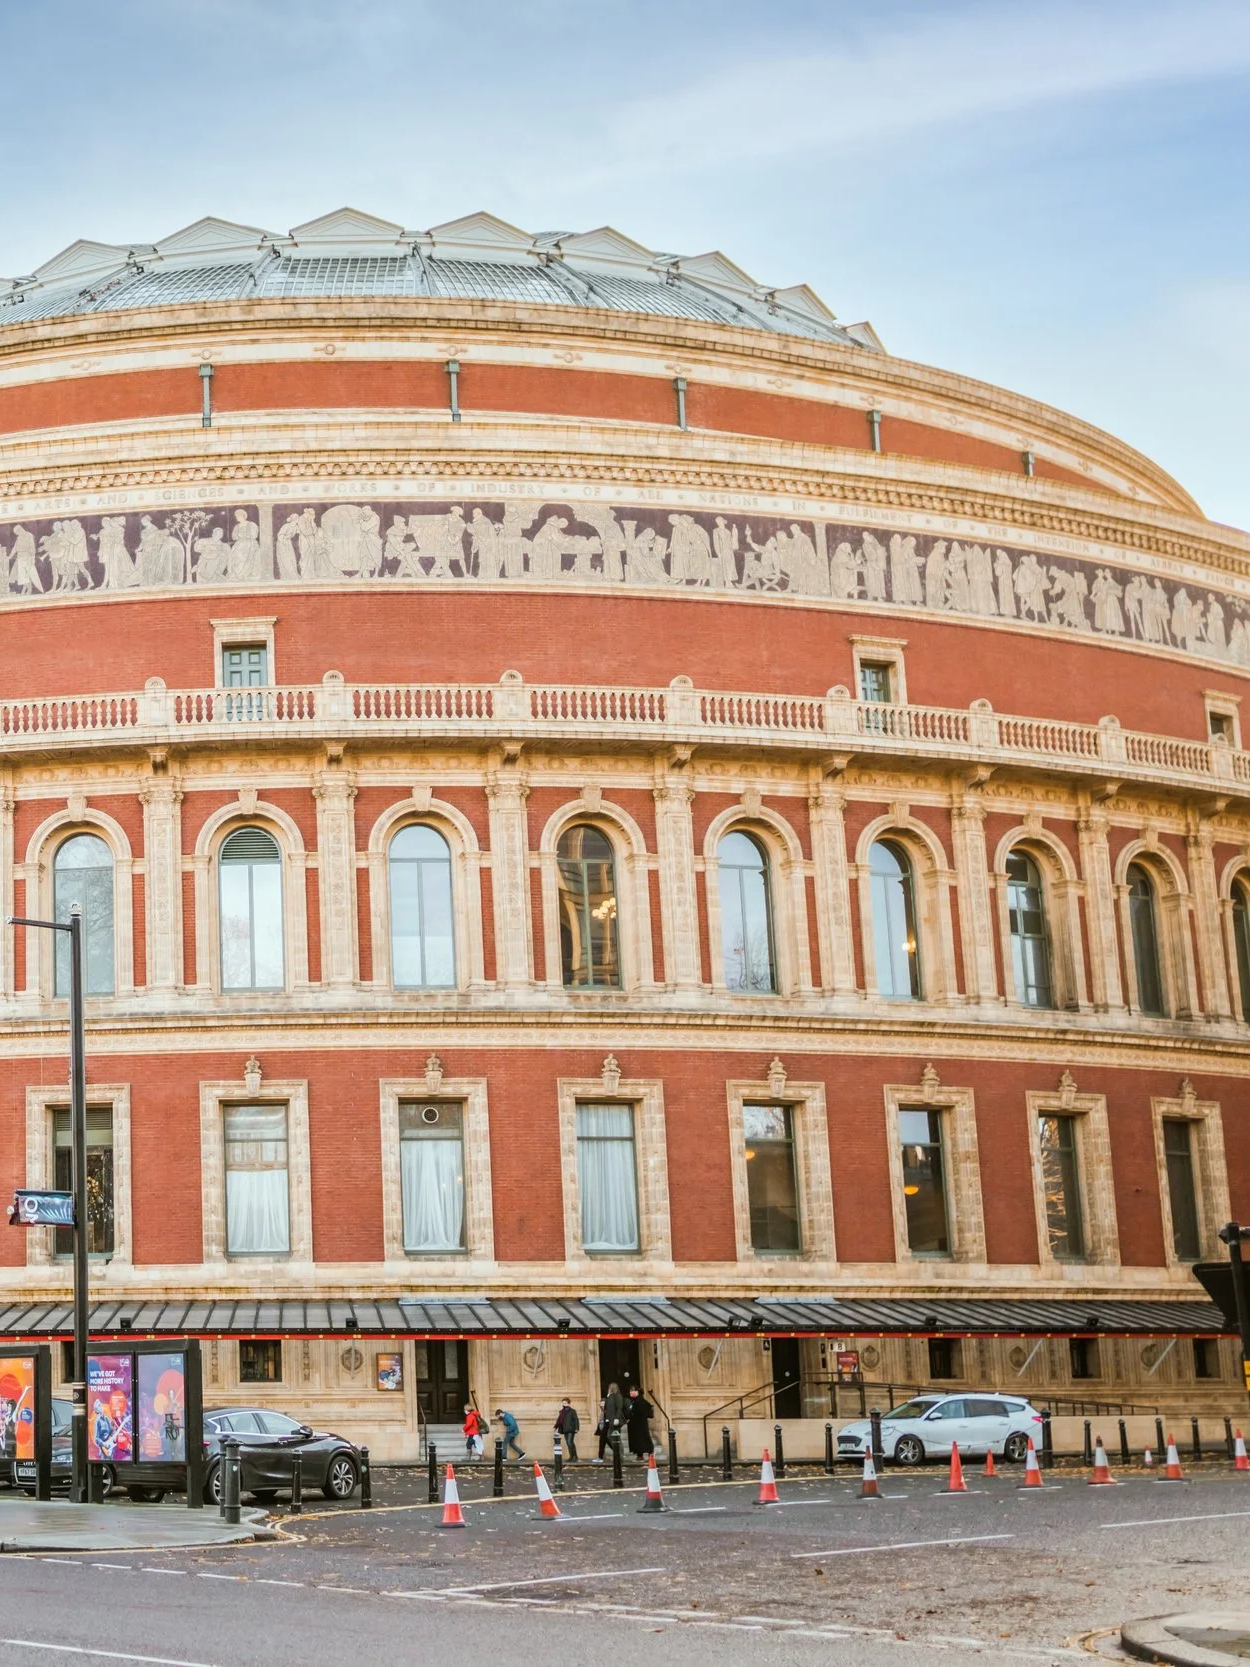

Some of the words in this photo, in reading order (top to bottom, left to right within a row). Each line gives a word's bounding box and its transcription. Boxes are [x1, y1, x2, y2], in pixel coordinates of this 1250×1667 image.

[34, 498, 71, 512] ARTS
[97, 493, 128, 505] AND
[154, 486, 225, 501] SCIENCES
[257, 484, 291, 496] AND
[416, 482, 436, 493] OF
[470, 482, 546, 495] INDUSTRY
[582, 486, 602, 497] OF
[637, 488, 664, 500] ALL
[698, 493, 759, 507] NATIONS
[792, 500, 806, 512] IN
